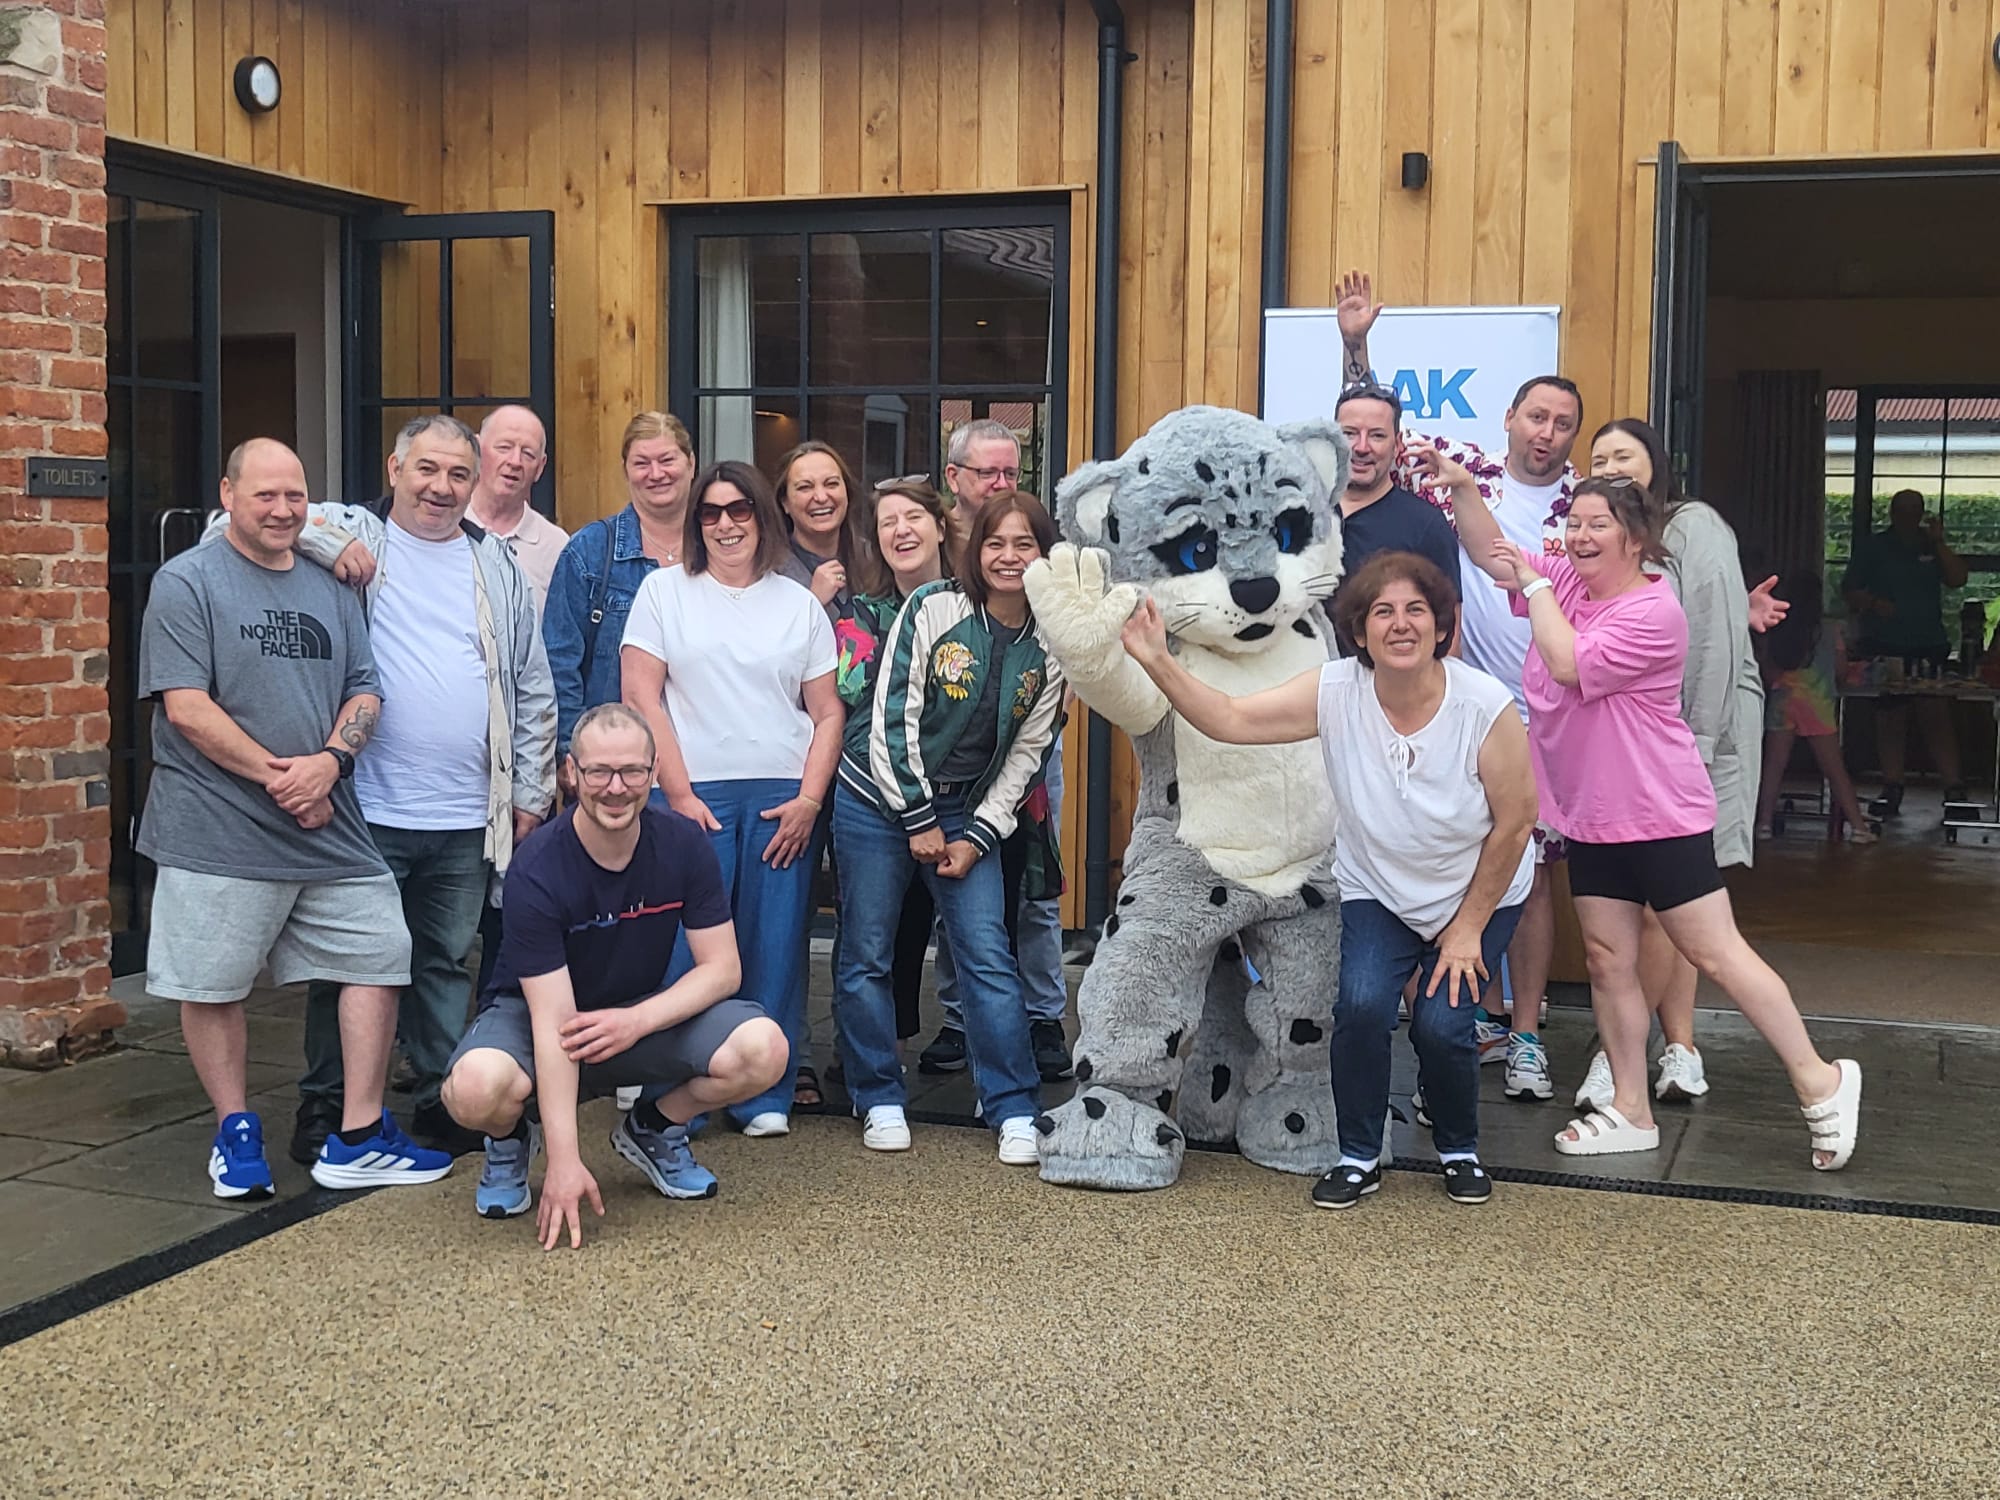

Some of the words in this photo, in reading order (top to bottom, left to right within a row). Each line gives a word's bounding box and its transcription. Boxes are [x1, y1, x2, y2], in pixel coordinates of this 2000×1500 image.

[1370, 368, 1477, 419] AK
[43, 468, 96, 486] TOILETS
[263, 609, 298, 626] THE
[240, 624, 299, 642] NORTH
[261, 641, 300, 659] FACE
